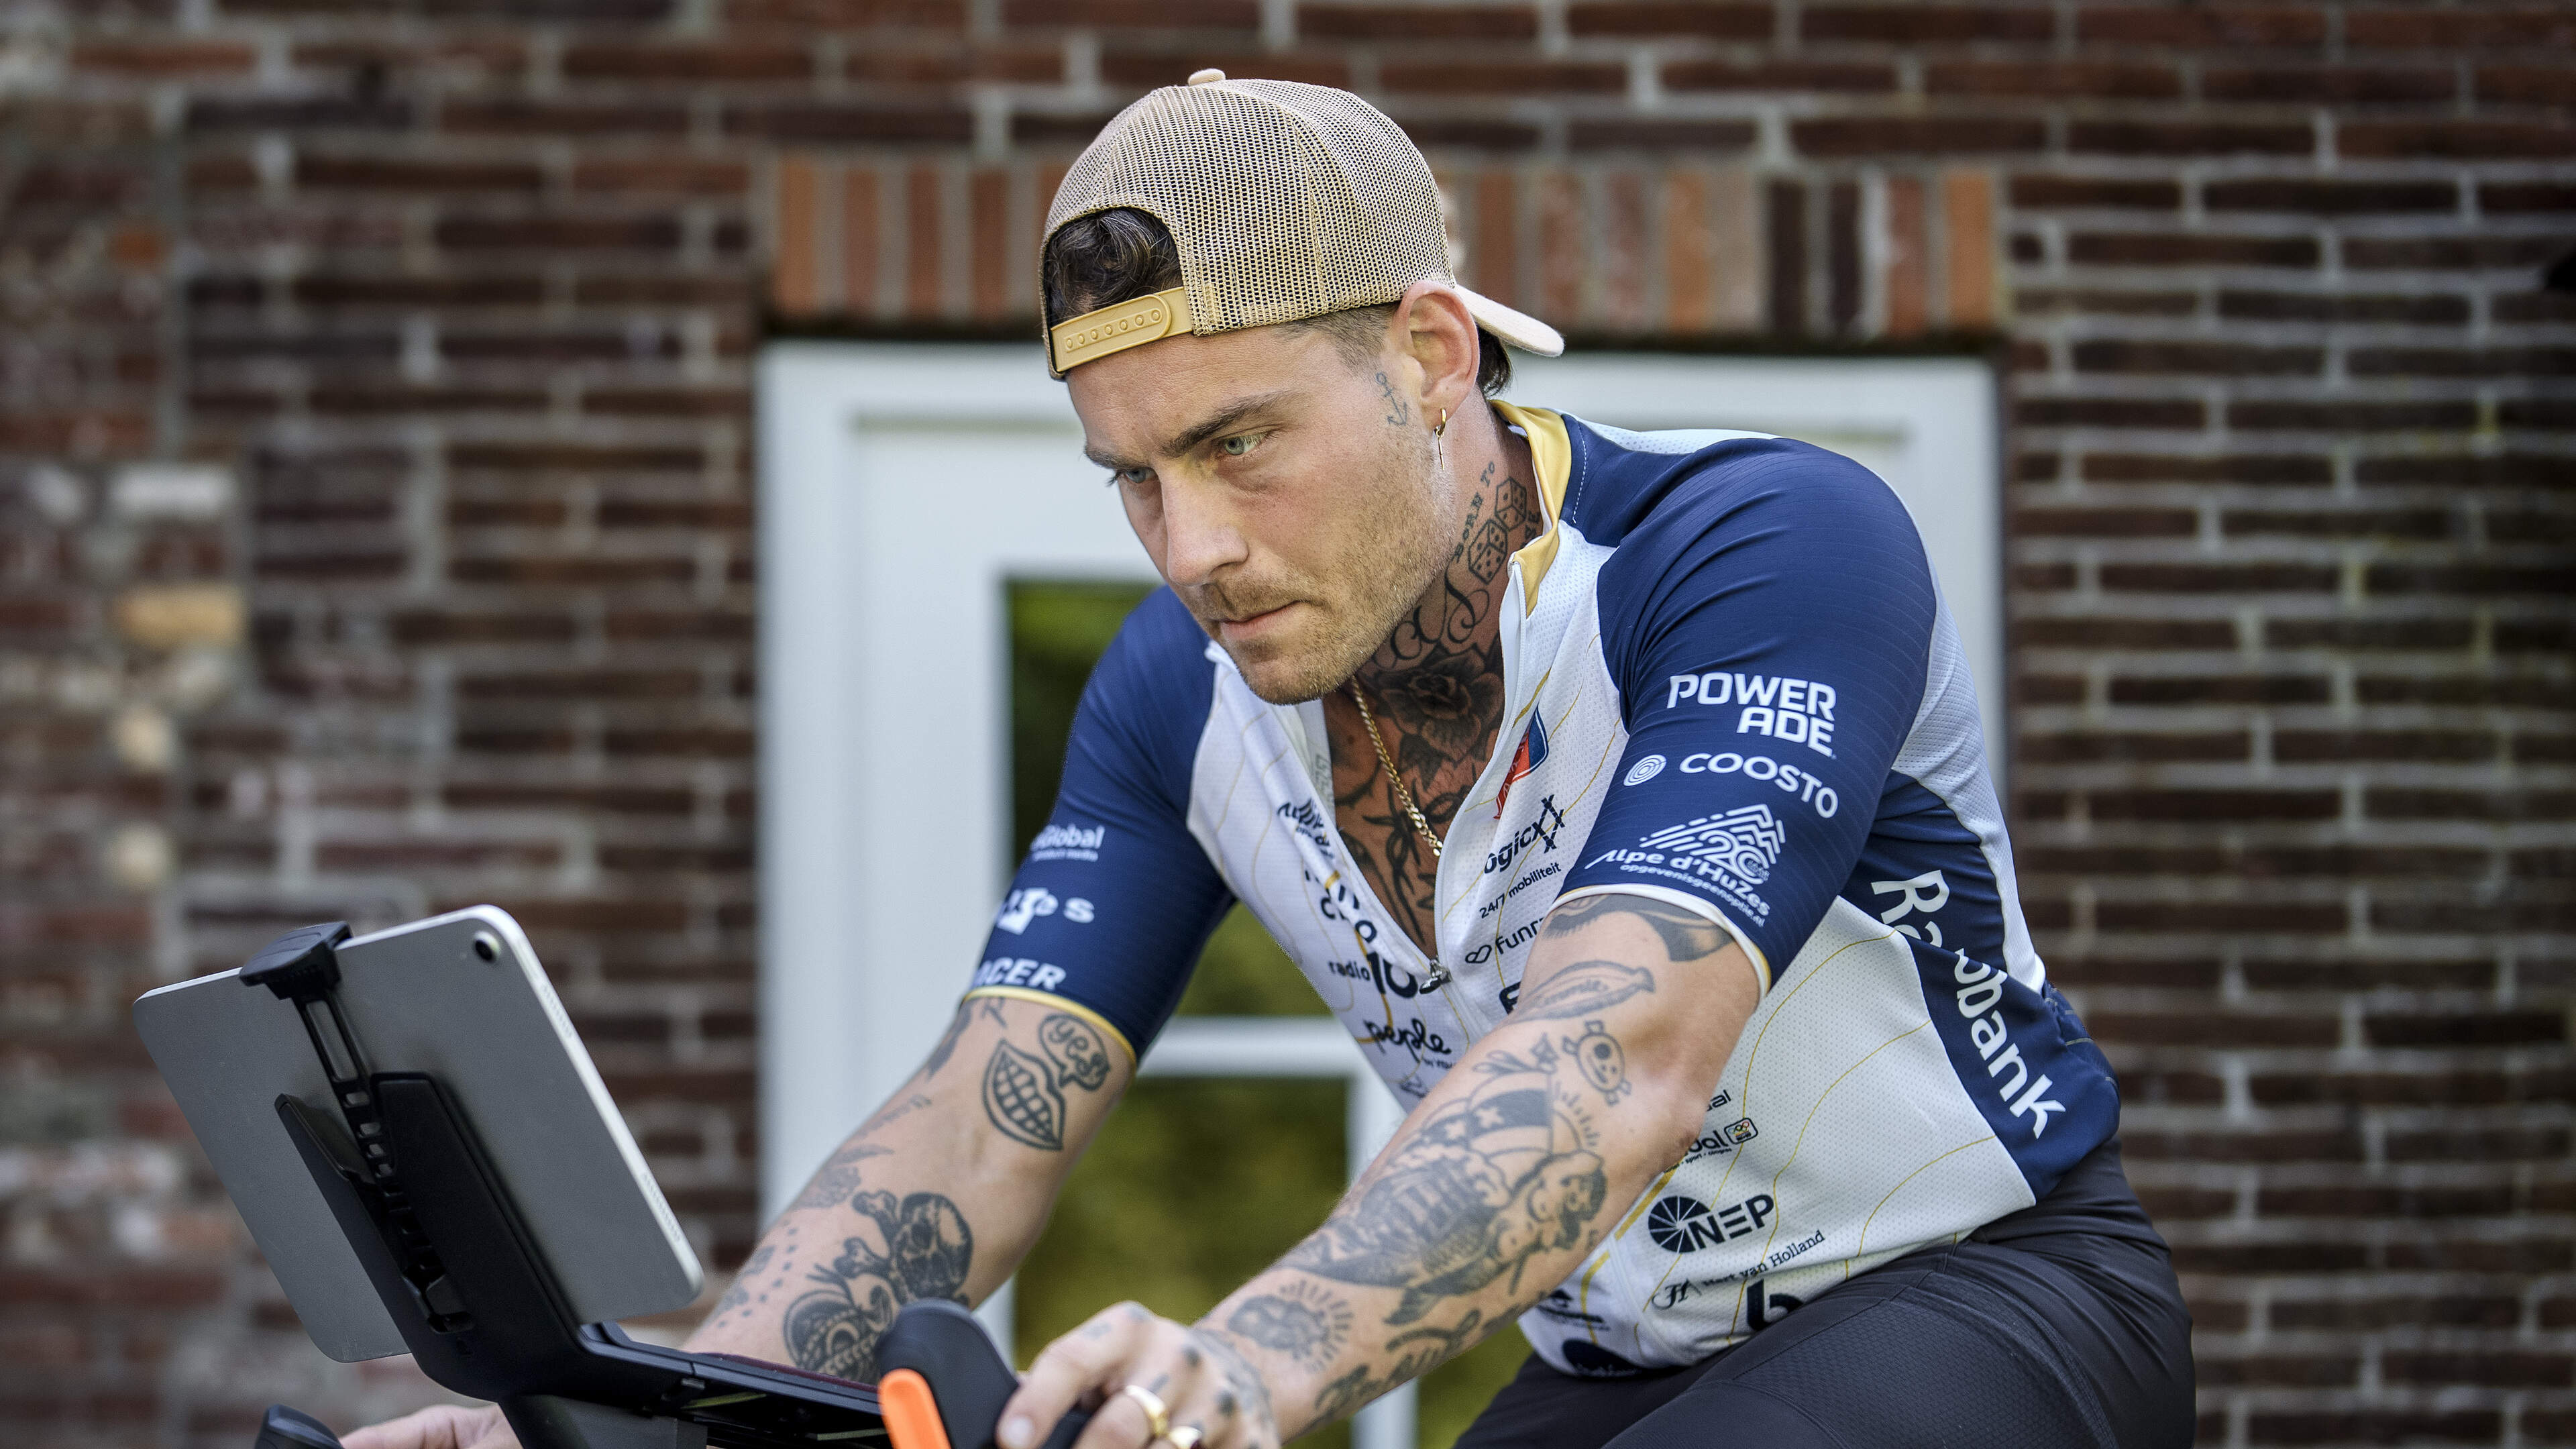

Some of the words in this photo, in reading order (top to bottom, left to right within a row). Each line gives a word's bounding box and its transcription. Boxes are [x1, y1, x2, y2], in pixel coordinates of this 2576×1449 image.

[1666, 672, 1837, 722] POWER
[1736, 706, 1835, 759] ADE
[1679, 753, 1839, 818] COOSTO
[1584, 849, 1665, 870] Alpe
[1479, 893, 1506, 919] 24/7
[1508, 861, 1562, 898] mobiliteit
[1495, 916, 1546, 955] funr
[1329, 961, 1371, 981] radio
[1687, 1194, 1775, 1250] NEP
[1739, 1263, 1769, 1280] van
[1768, 1230, 1826, 1268] Holland
